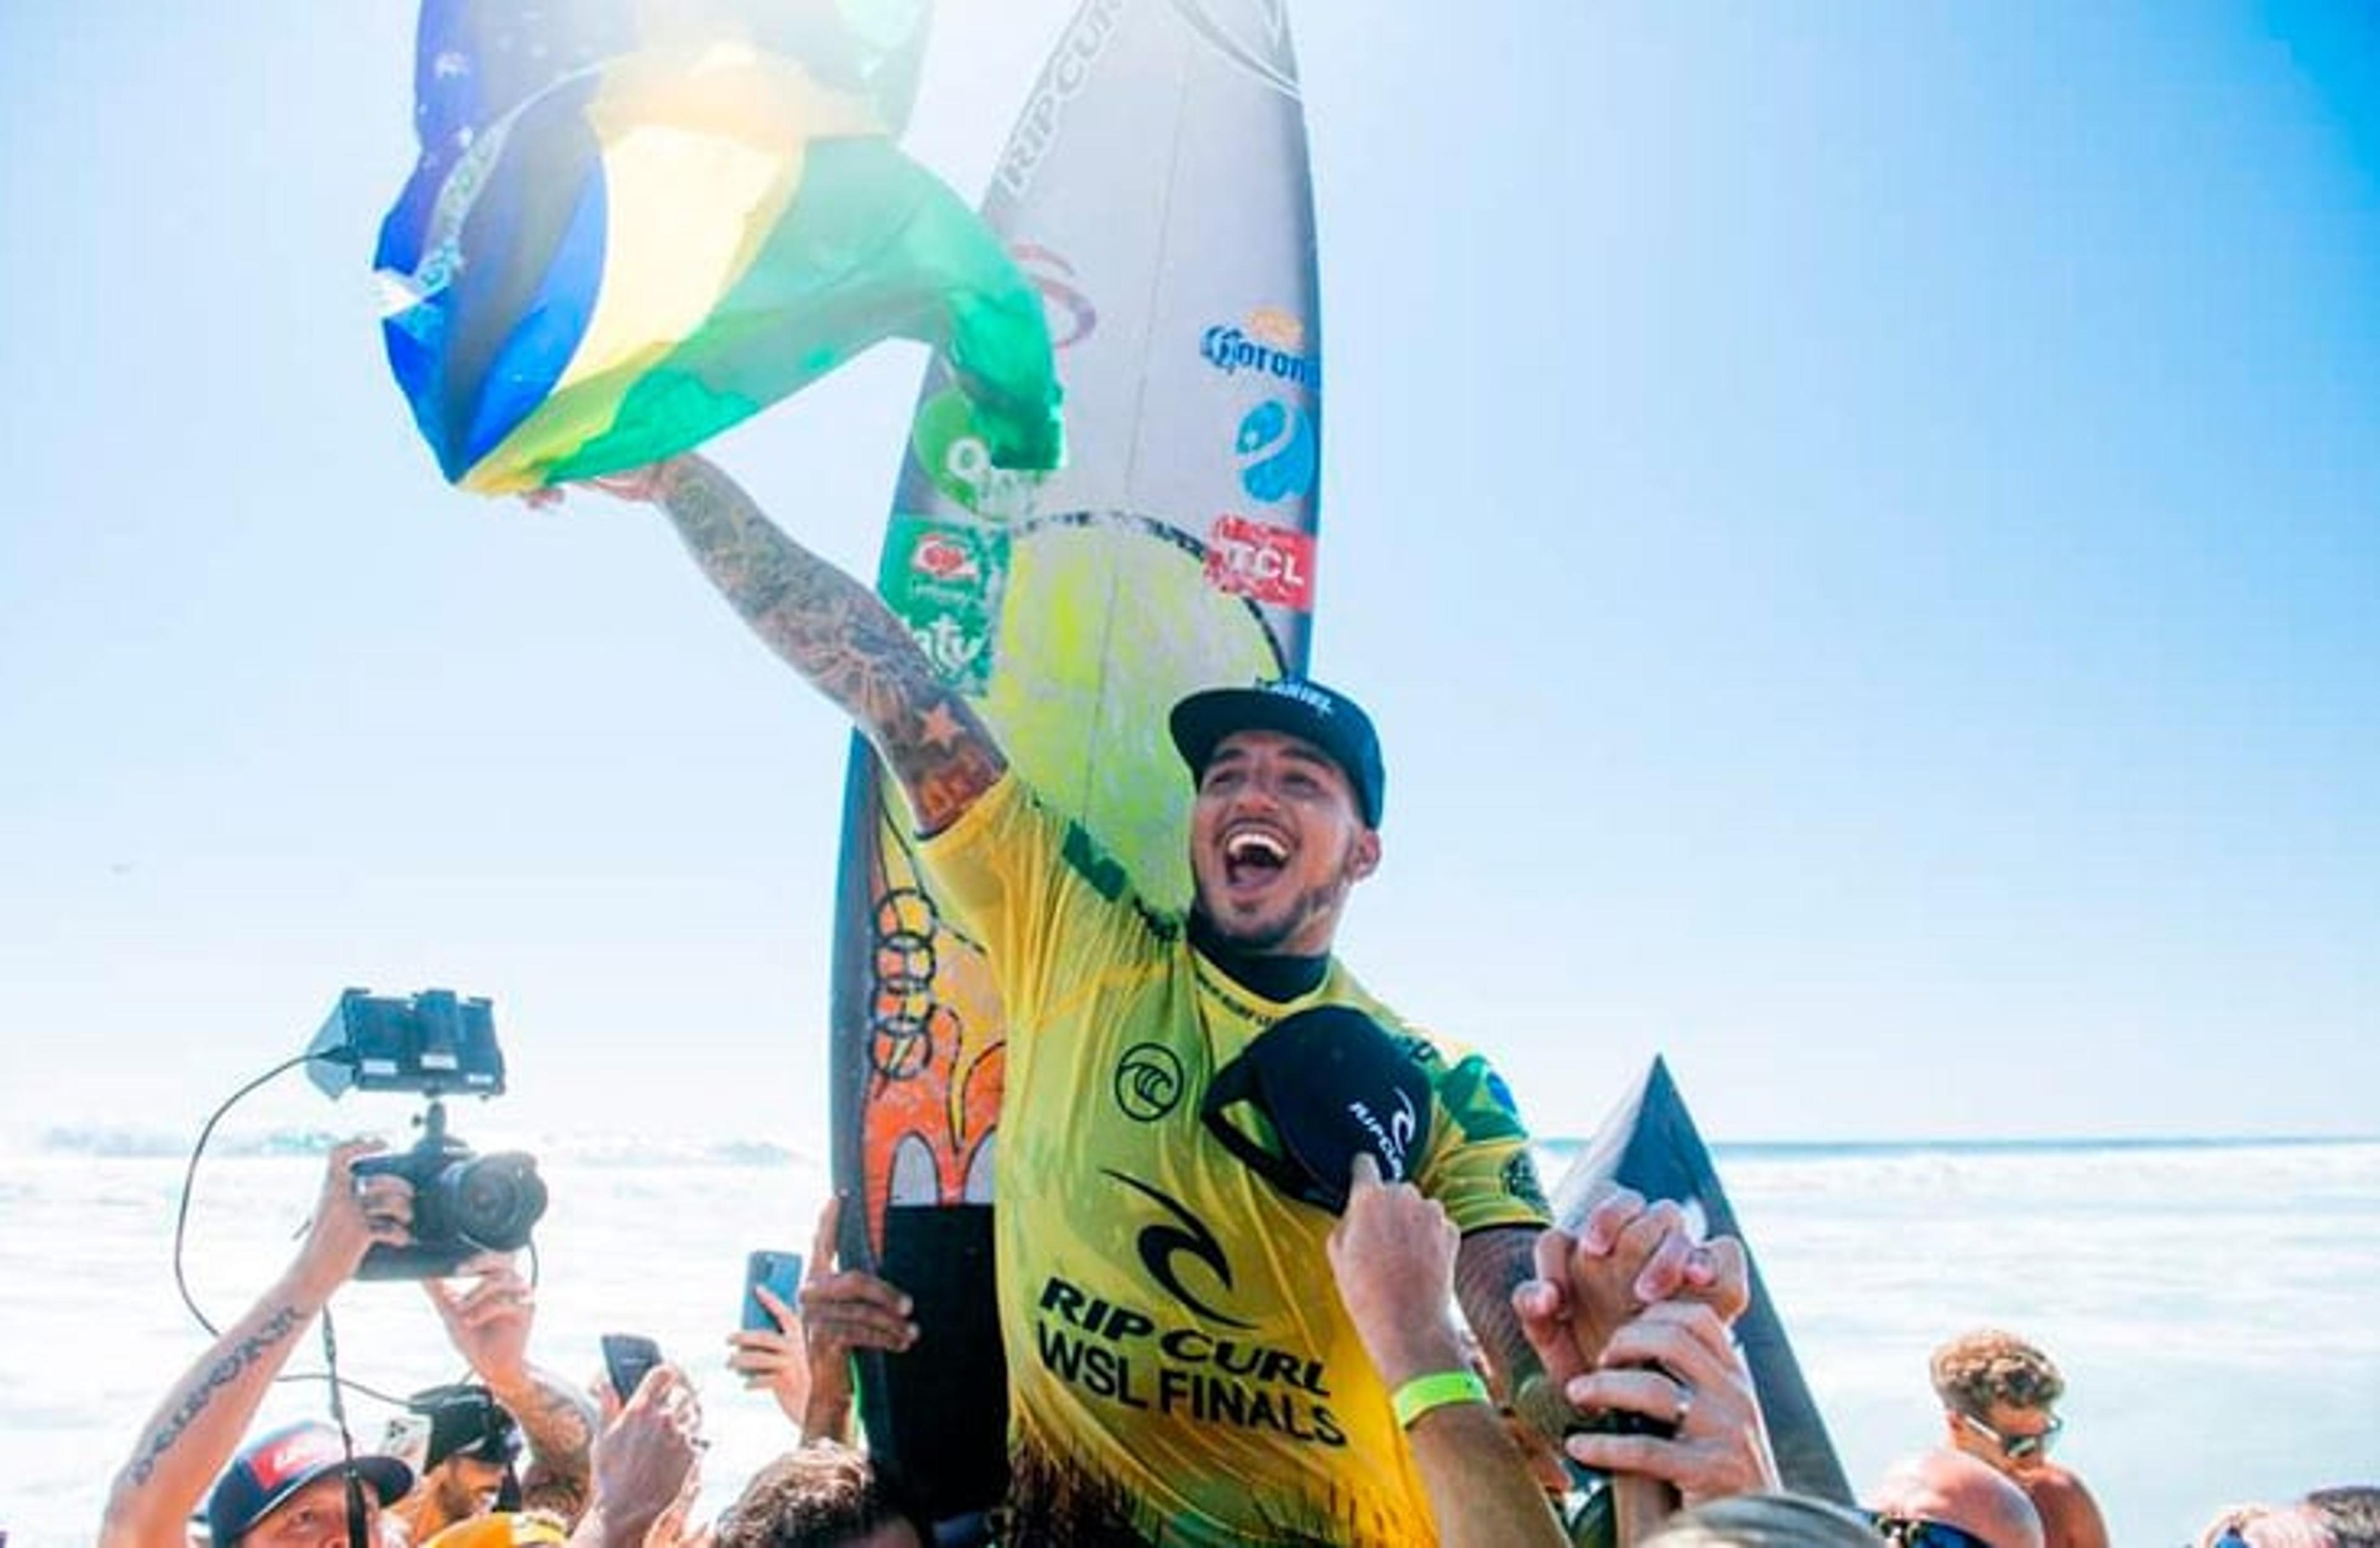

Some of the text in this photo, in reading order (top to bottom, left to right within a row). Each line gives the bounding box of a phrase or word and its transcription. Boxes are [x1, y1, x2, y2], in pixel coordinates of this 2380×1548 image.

[1003, 94, 1057, 188] RIP
[1200, 324, 1319, 384] Coron
[1224, 540, 1304, 586] TCL
[1038, 1319, 1347, 1448] WSL FINALS
[1039, 1277, 1331, 1397] RIP CURL
